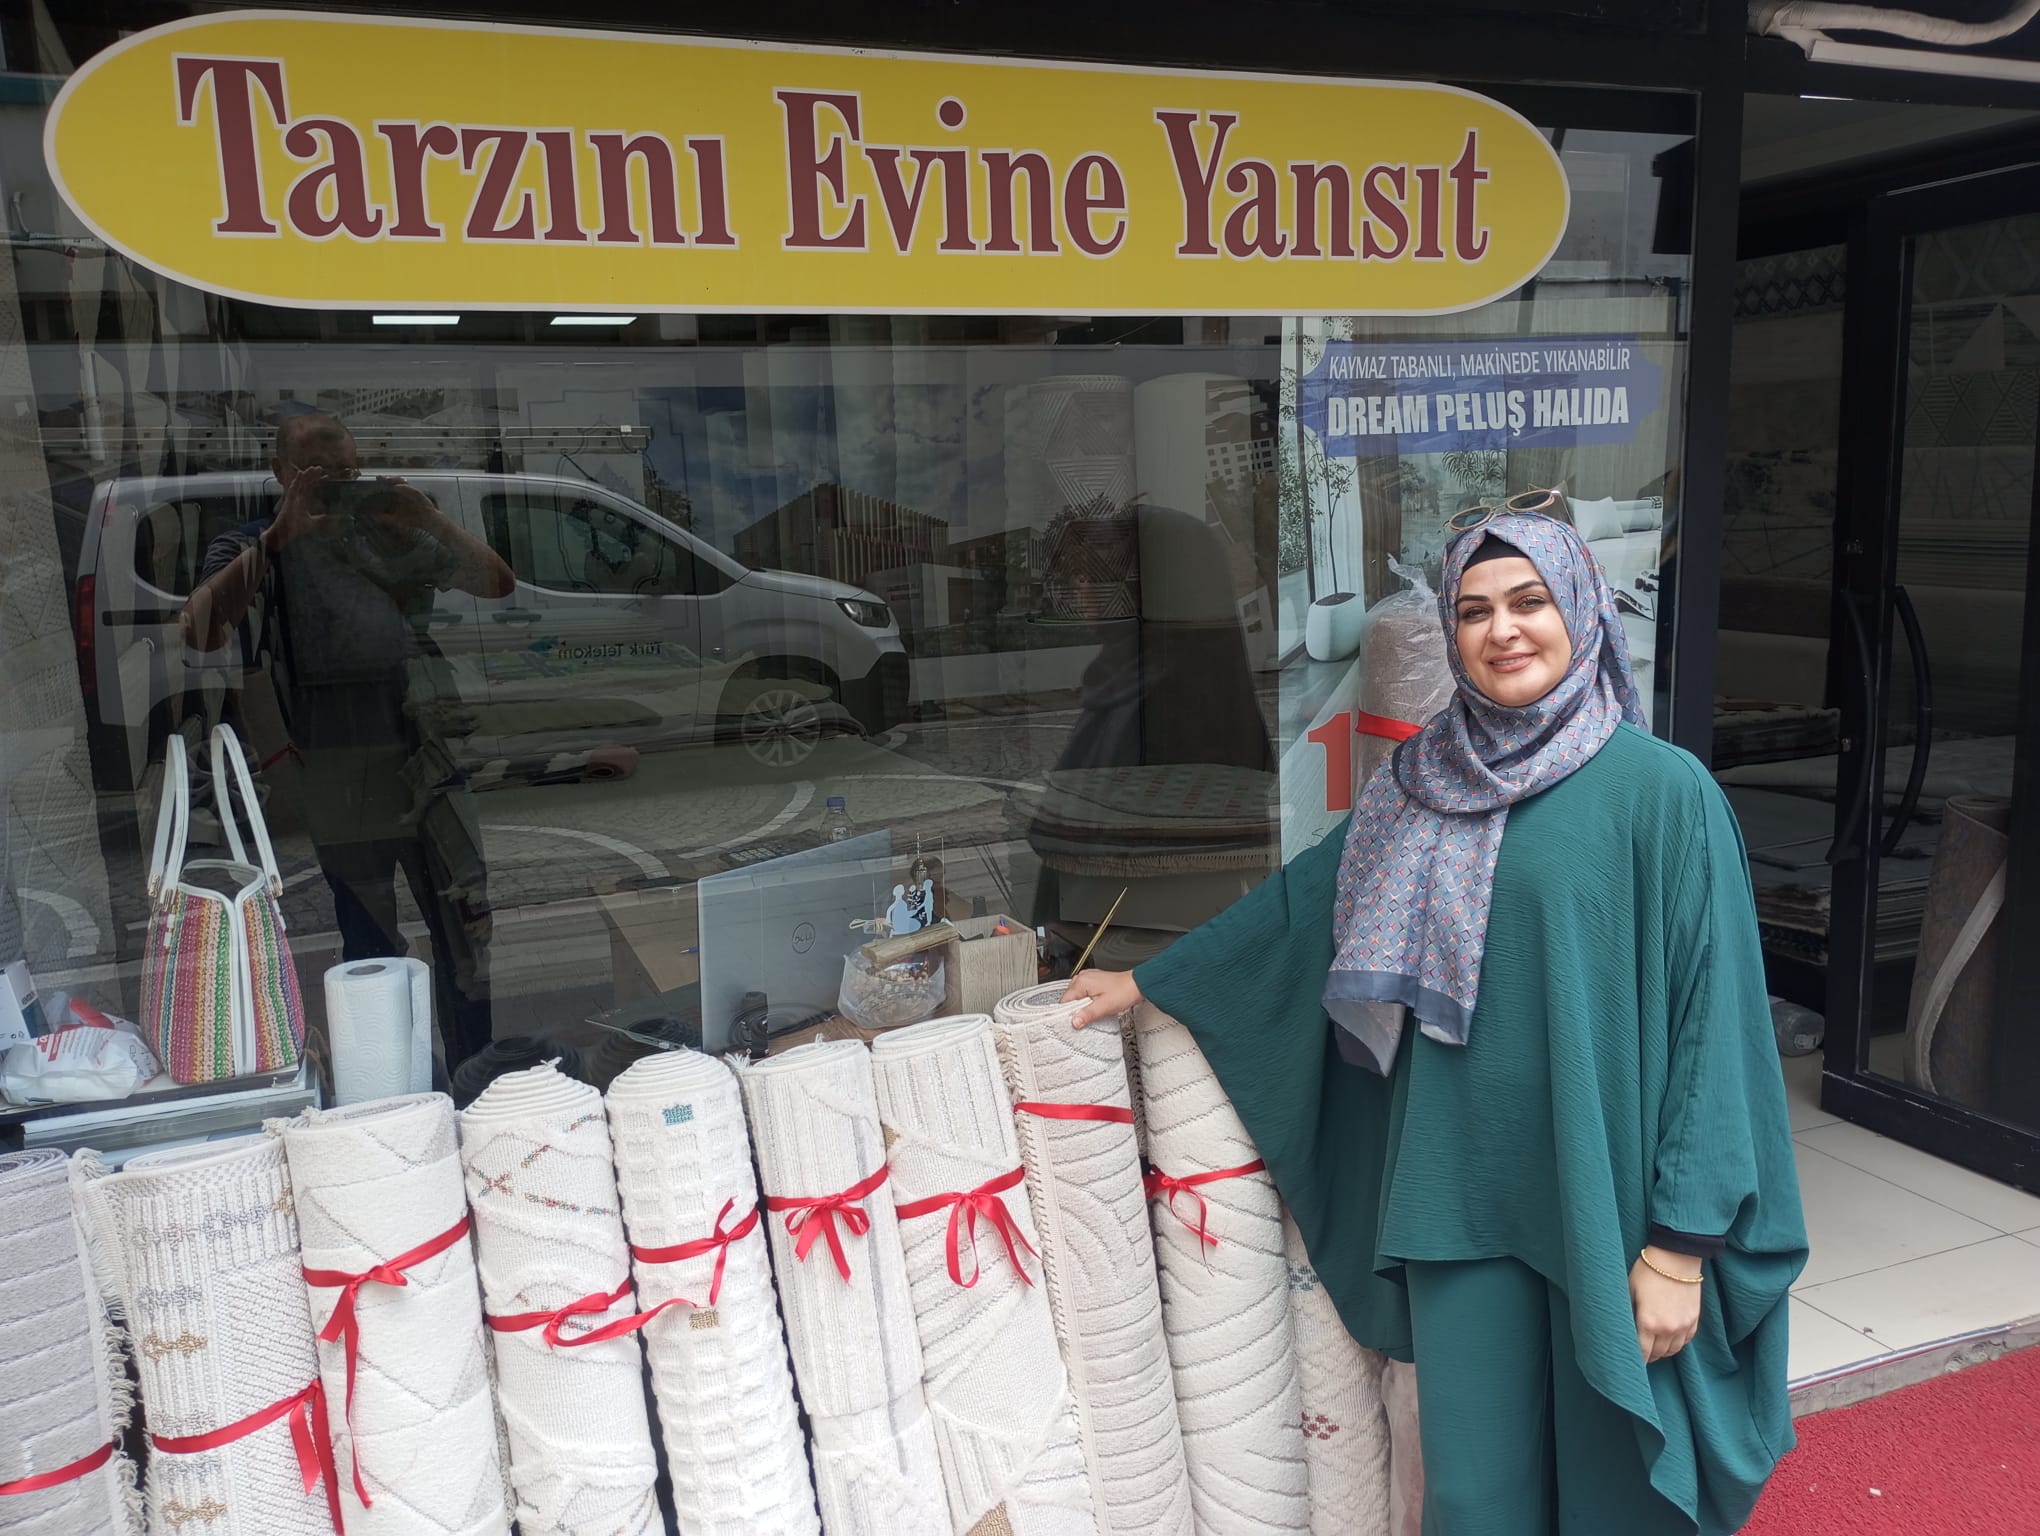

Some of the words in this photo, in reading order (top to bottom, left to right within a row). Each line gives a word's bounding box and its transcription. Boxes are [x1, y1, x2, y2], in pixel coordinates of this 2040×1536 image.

[176, 57, 737, 245] Tarzını
[776, 90, 1126, 255] Evine
[1155, 110, 1489, 262] Yansıt
[1329, 355, 1387, 380] KAYMAZ
[1391, 353, 1456, 381] TABANLI,
[1461, 347, 1541, 378] MAKİNEDE
[1545, 342, 1631, 373] YIKANABİLİR
[1328, 395, 1429, 437] DREAM
[1437, 389, 1526, 437] PELUŞ
[1532, 386, 1630, 428] HALIDA
